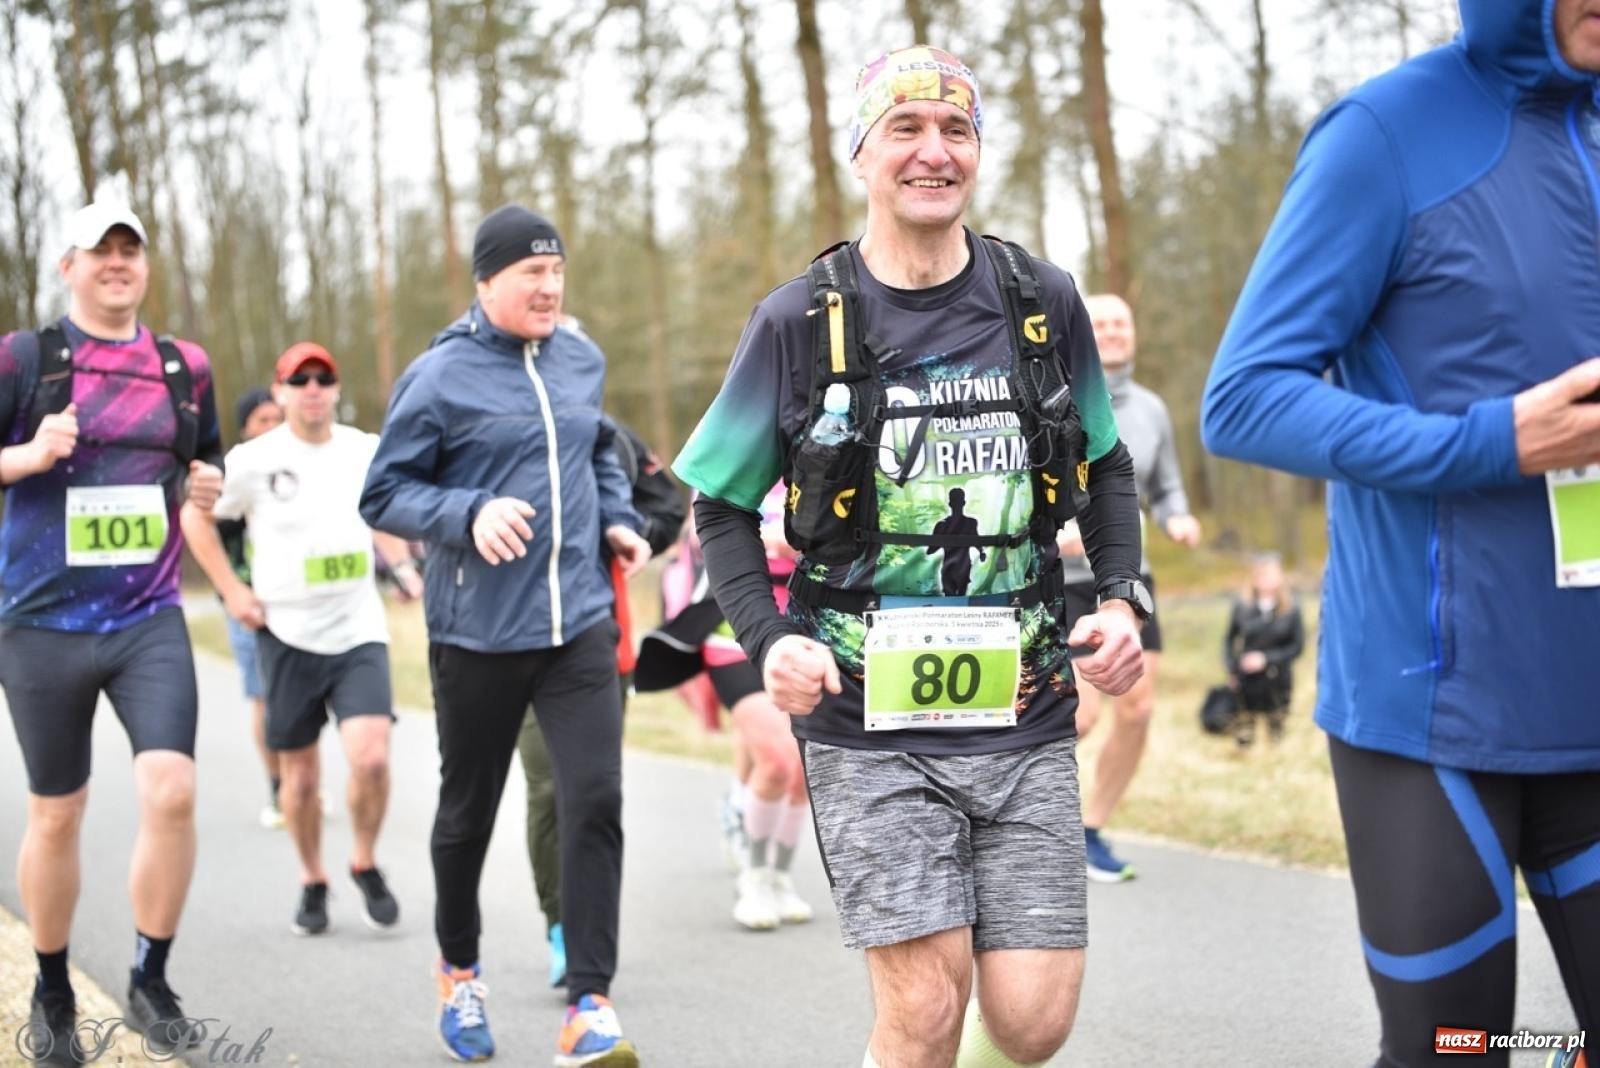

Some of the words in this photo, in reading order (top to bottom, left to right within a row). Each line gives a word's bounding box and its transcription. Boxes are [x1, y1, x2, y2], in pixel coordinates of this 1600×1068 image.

[85, 516, 153, 549] 101
[323, 553, 356, 580] 89
[911, 652, 981, 706] 80
